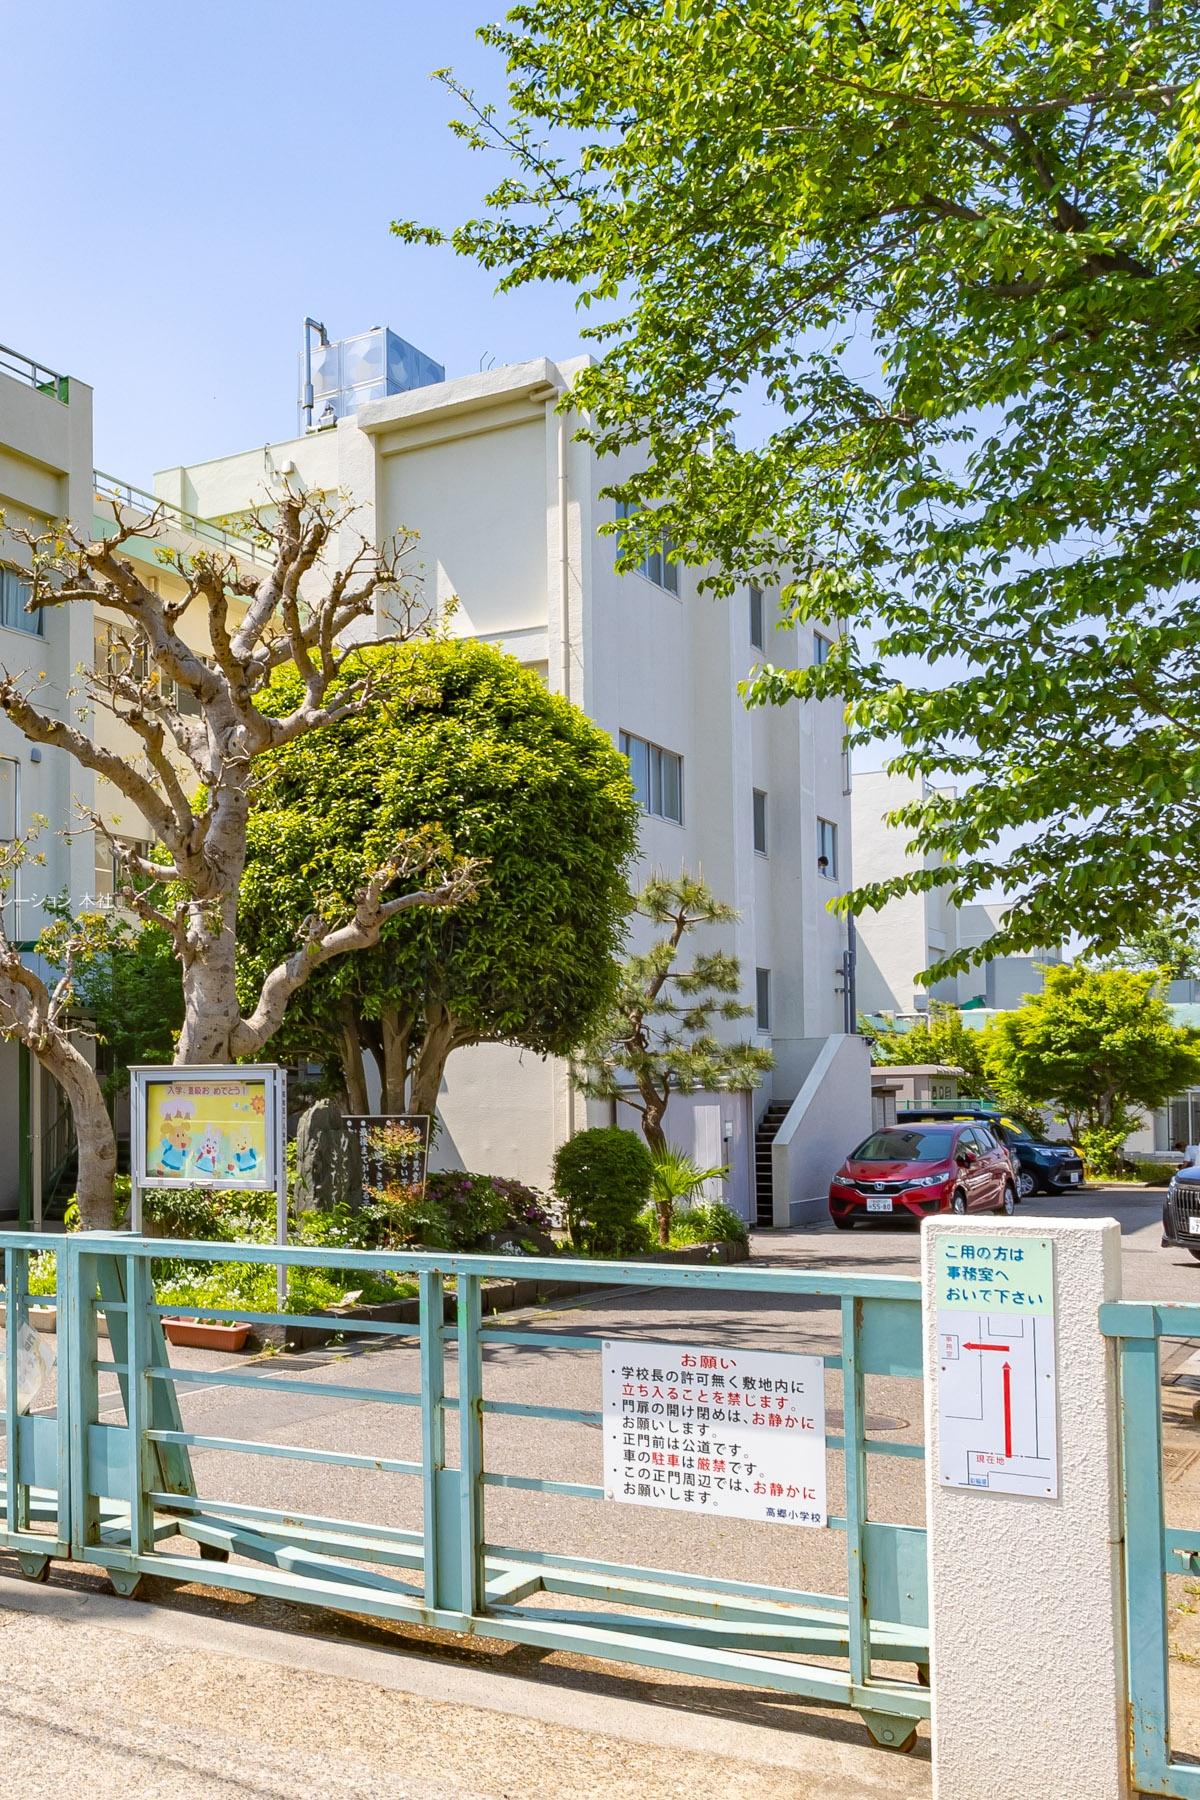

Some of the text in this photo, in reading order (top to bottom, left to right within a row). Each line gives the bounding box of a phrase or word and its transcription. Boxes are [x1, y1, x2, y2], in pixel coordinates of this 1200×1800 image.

[945, 1245, 1024, 1262] ご用の方は
[946, 1266, 1009, 1282] 事務室へ
[946, 1287, 1043, 1305] おいで下さい
[681, 1353, 737, 1369] お願い
[622, 1382, 796, 1412] 立ち入ることを禁じます。
[622, 1416, 717, 1439] お願いします。
[623, 1449, 766, 1478] 車の駐車は厳禁です。
[976, 1454, 1005, 1465] 現在地
[624, 1482, 719, 1507] お願いします。
